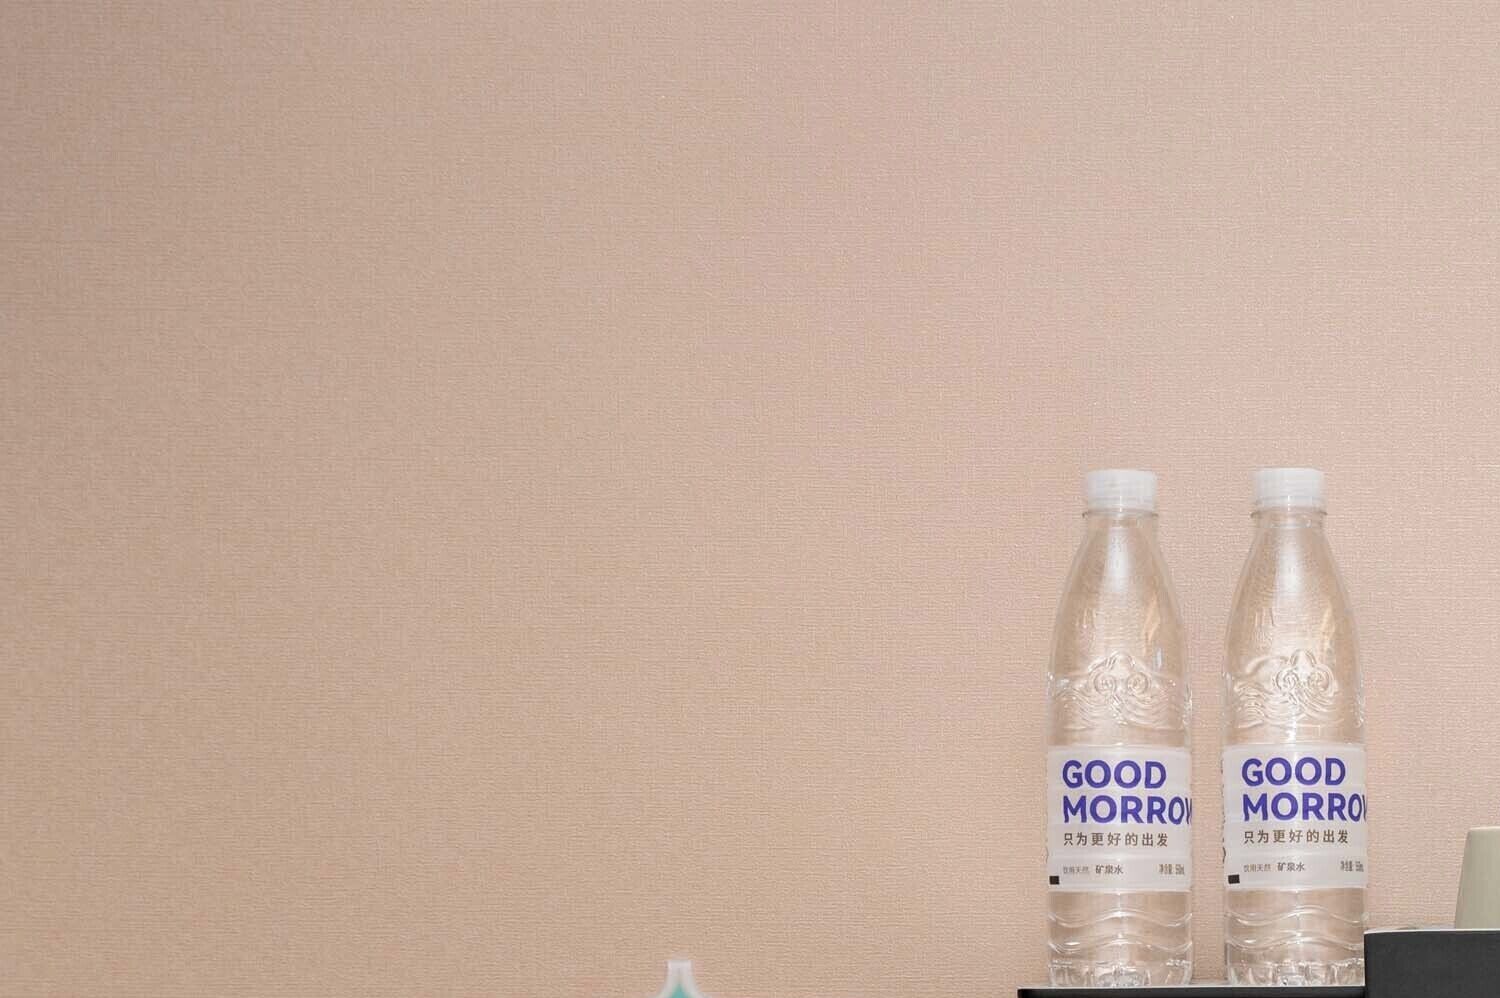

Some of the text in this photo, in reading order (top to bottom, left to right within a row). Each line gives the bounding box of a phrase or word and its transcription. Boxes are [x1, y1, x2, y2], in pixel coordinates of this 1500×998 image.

[1062, 759, 1167, 789] GOOD
[1241, 757, 1346, 787] GOOD
[1063, 832, 1168, 847] 只为更好的出发
[1244, 829, 1349, 844] 只为更好的出发
[1095, 864, 1124, 875] 矿泉水
[1277, 861, 1305, 872] 矿泉水
